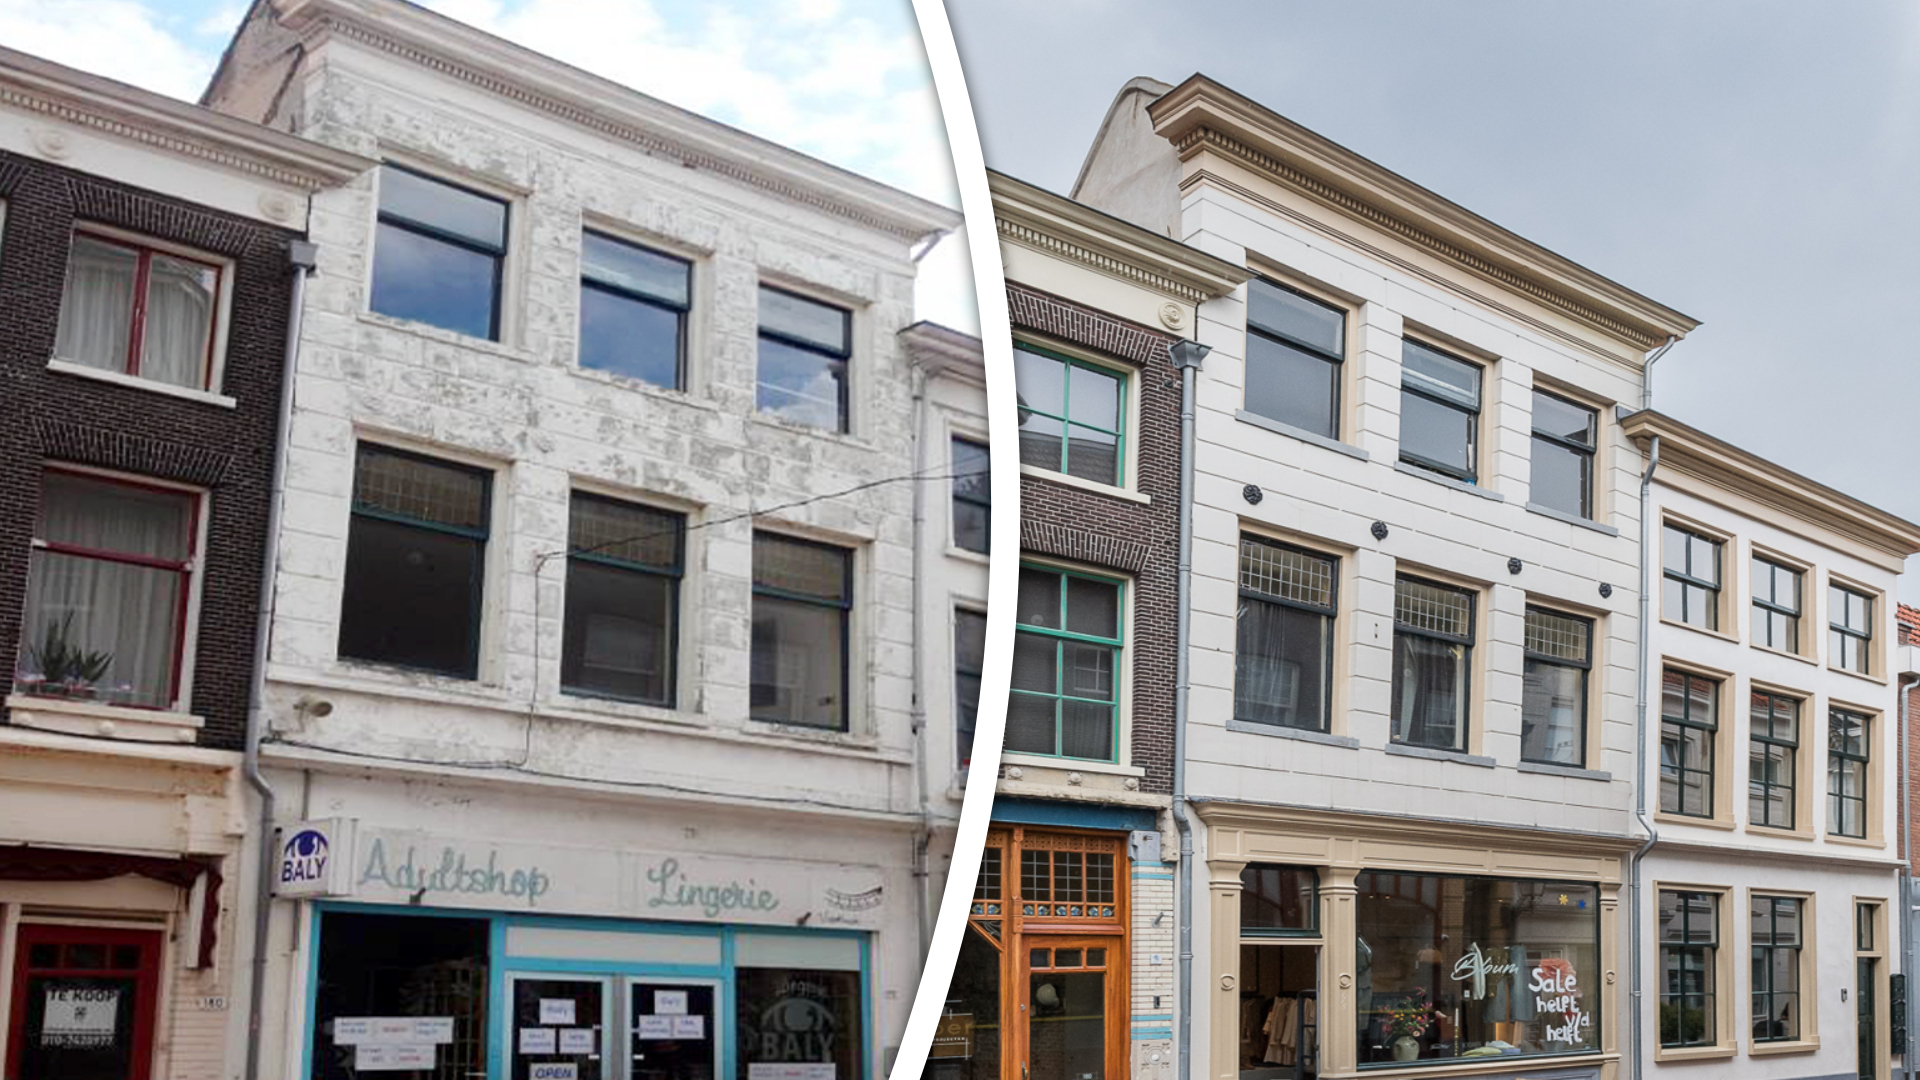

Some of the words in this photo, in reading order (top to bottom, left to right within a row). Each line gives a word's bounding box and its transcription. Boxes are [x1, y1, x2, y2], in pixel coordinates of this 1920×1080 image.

[282, 856, 328, 882] BALY
[357, 838, 549, 907] Adultshop
[647, 857, 780, 919] Lingerie
[1527, 967, 1578, 993] Sale
[50, 988, 69, 1001] TE
[72, 988, 117, 1004] KOOP
[1536, 995, 1580, 1013] helft
[761, 1031, 835, 1063] BALY
[1546, 1024, 1583, 1045] helft
[534, 1067, 572, 1079] OPEN
